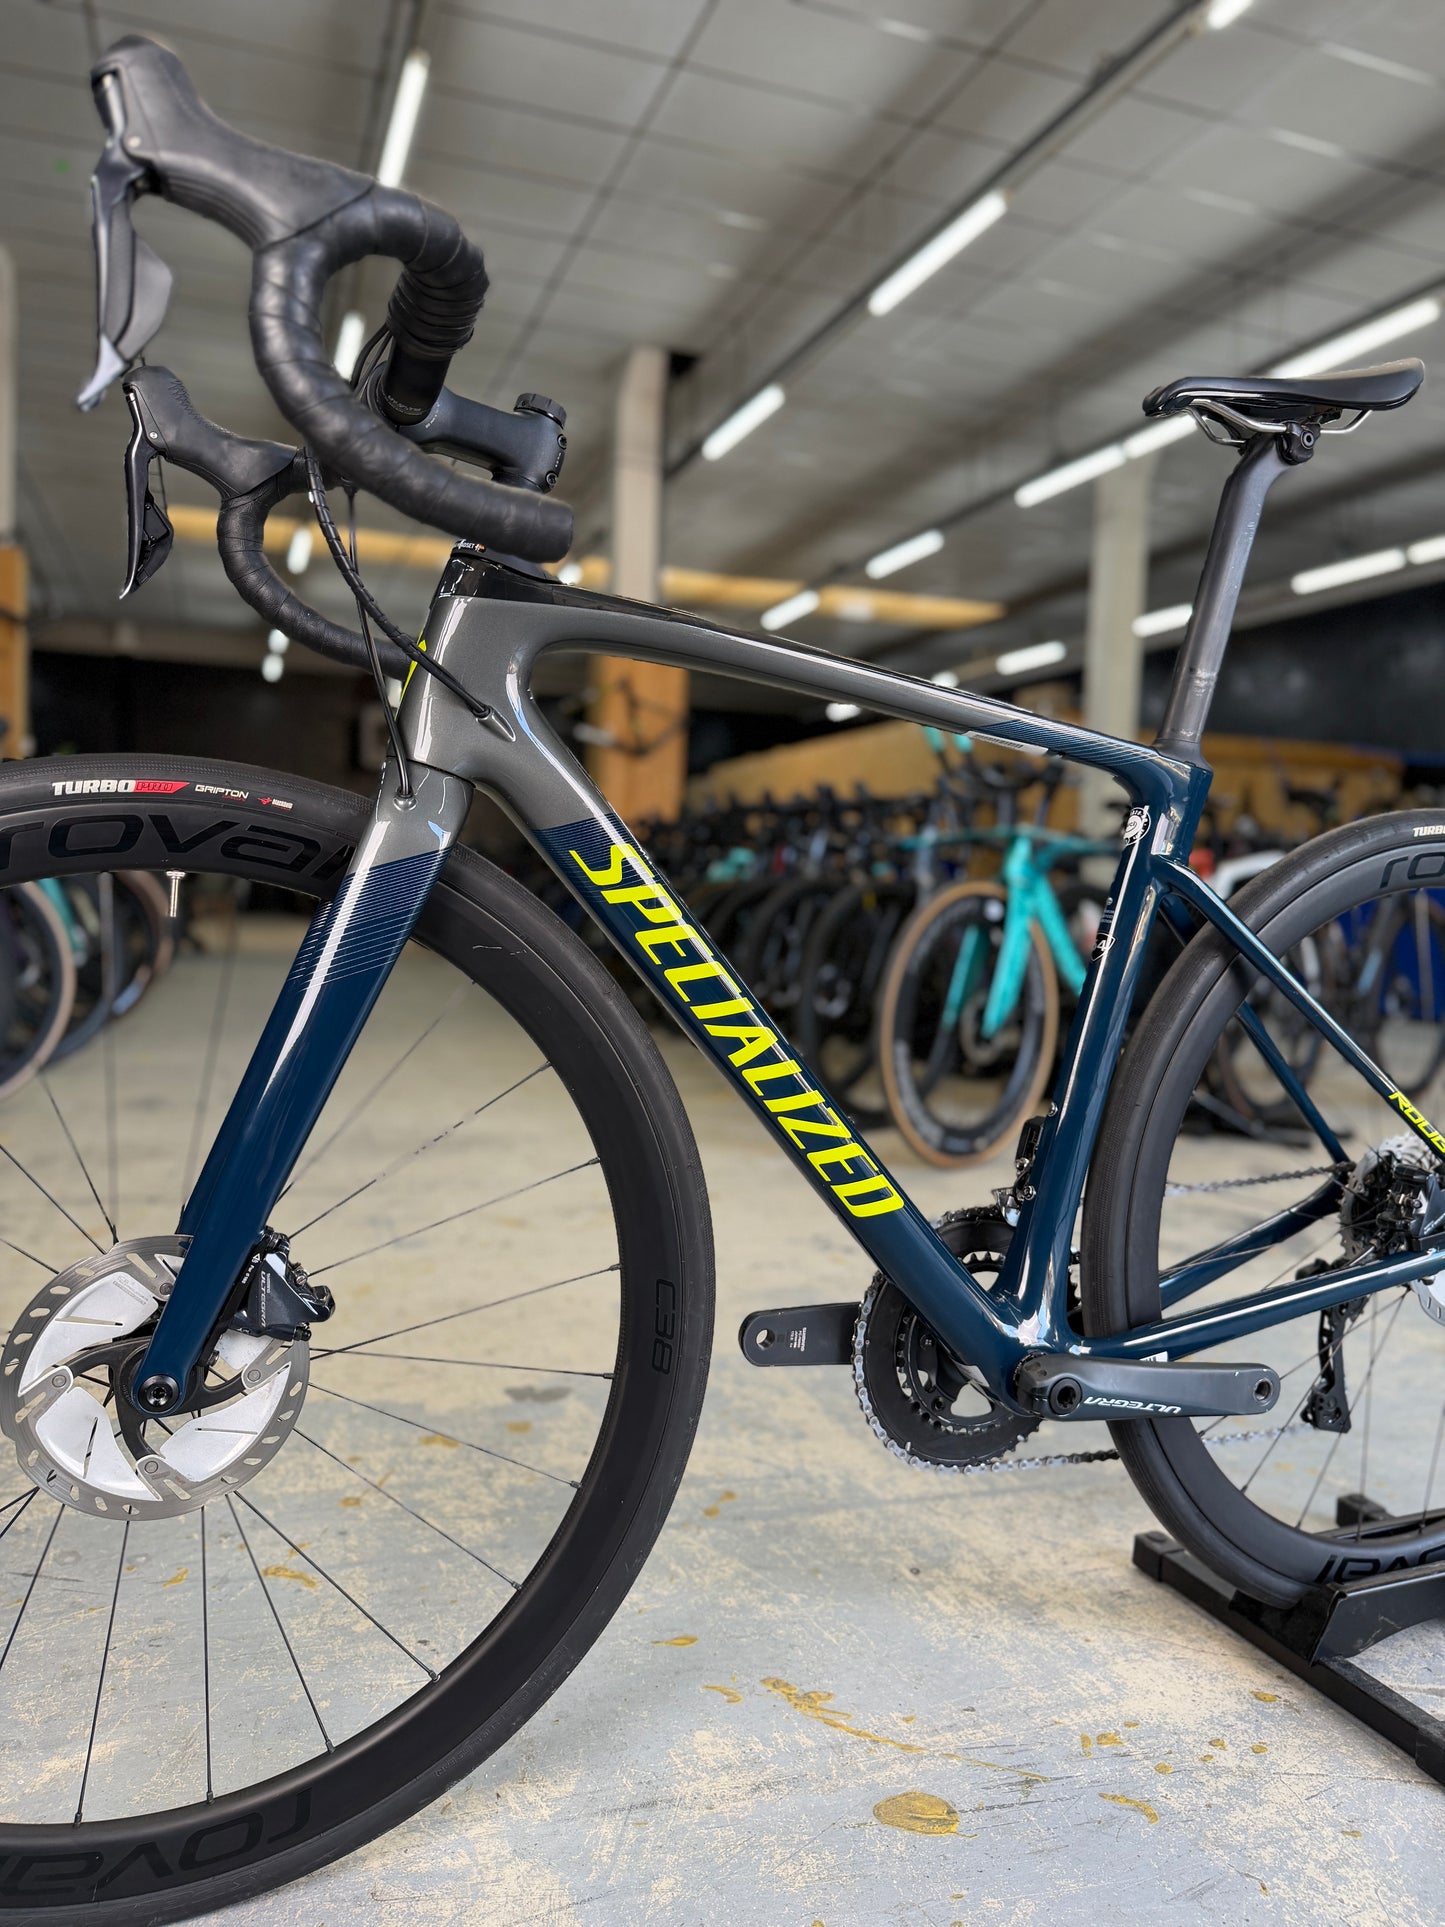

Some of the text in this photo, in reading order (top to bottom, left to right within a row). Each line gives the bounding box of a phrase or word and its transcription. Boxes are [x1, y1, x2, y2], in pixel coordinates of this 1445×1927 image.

[52, 780, 136, 795] TURBO
[195, 785, 249, 799] GRIPTON
[1412, 825, 1445, 838] TURB
[568, 843, 905, 1218] SPECIALIZED
[652, 1279, 676, 1375] C38
[1083, 1396, 1182, 1415] ULTEGRA
[0, 1787, 313, 1897] rova
